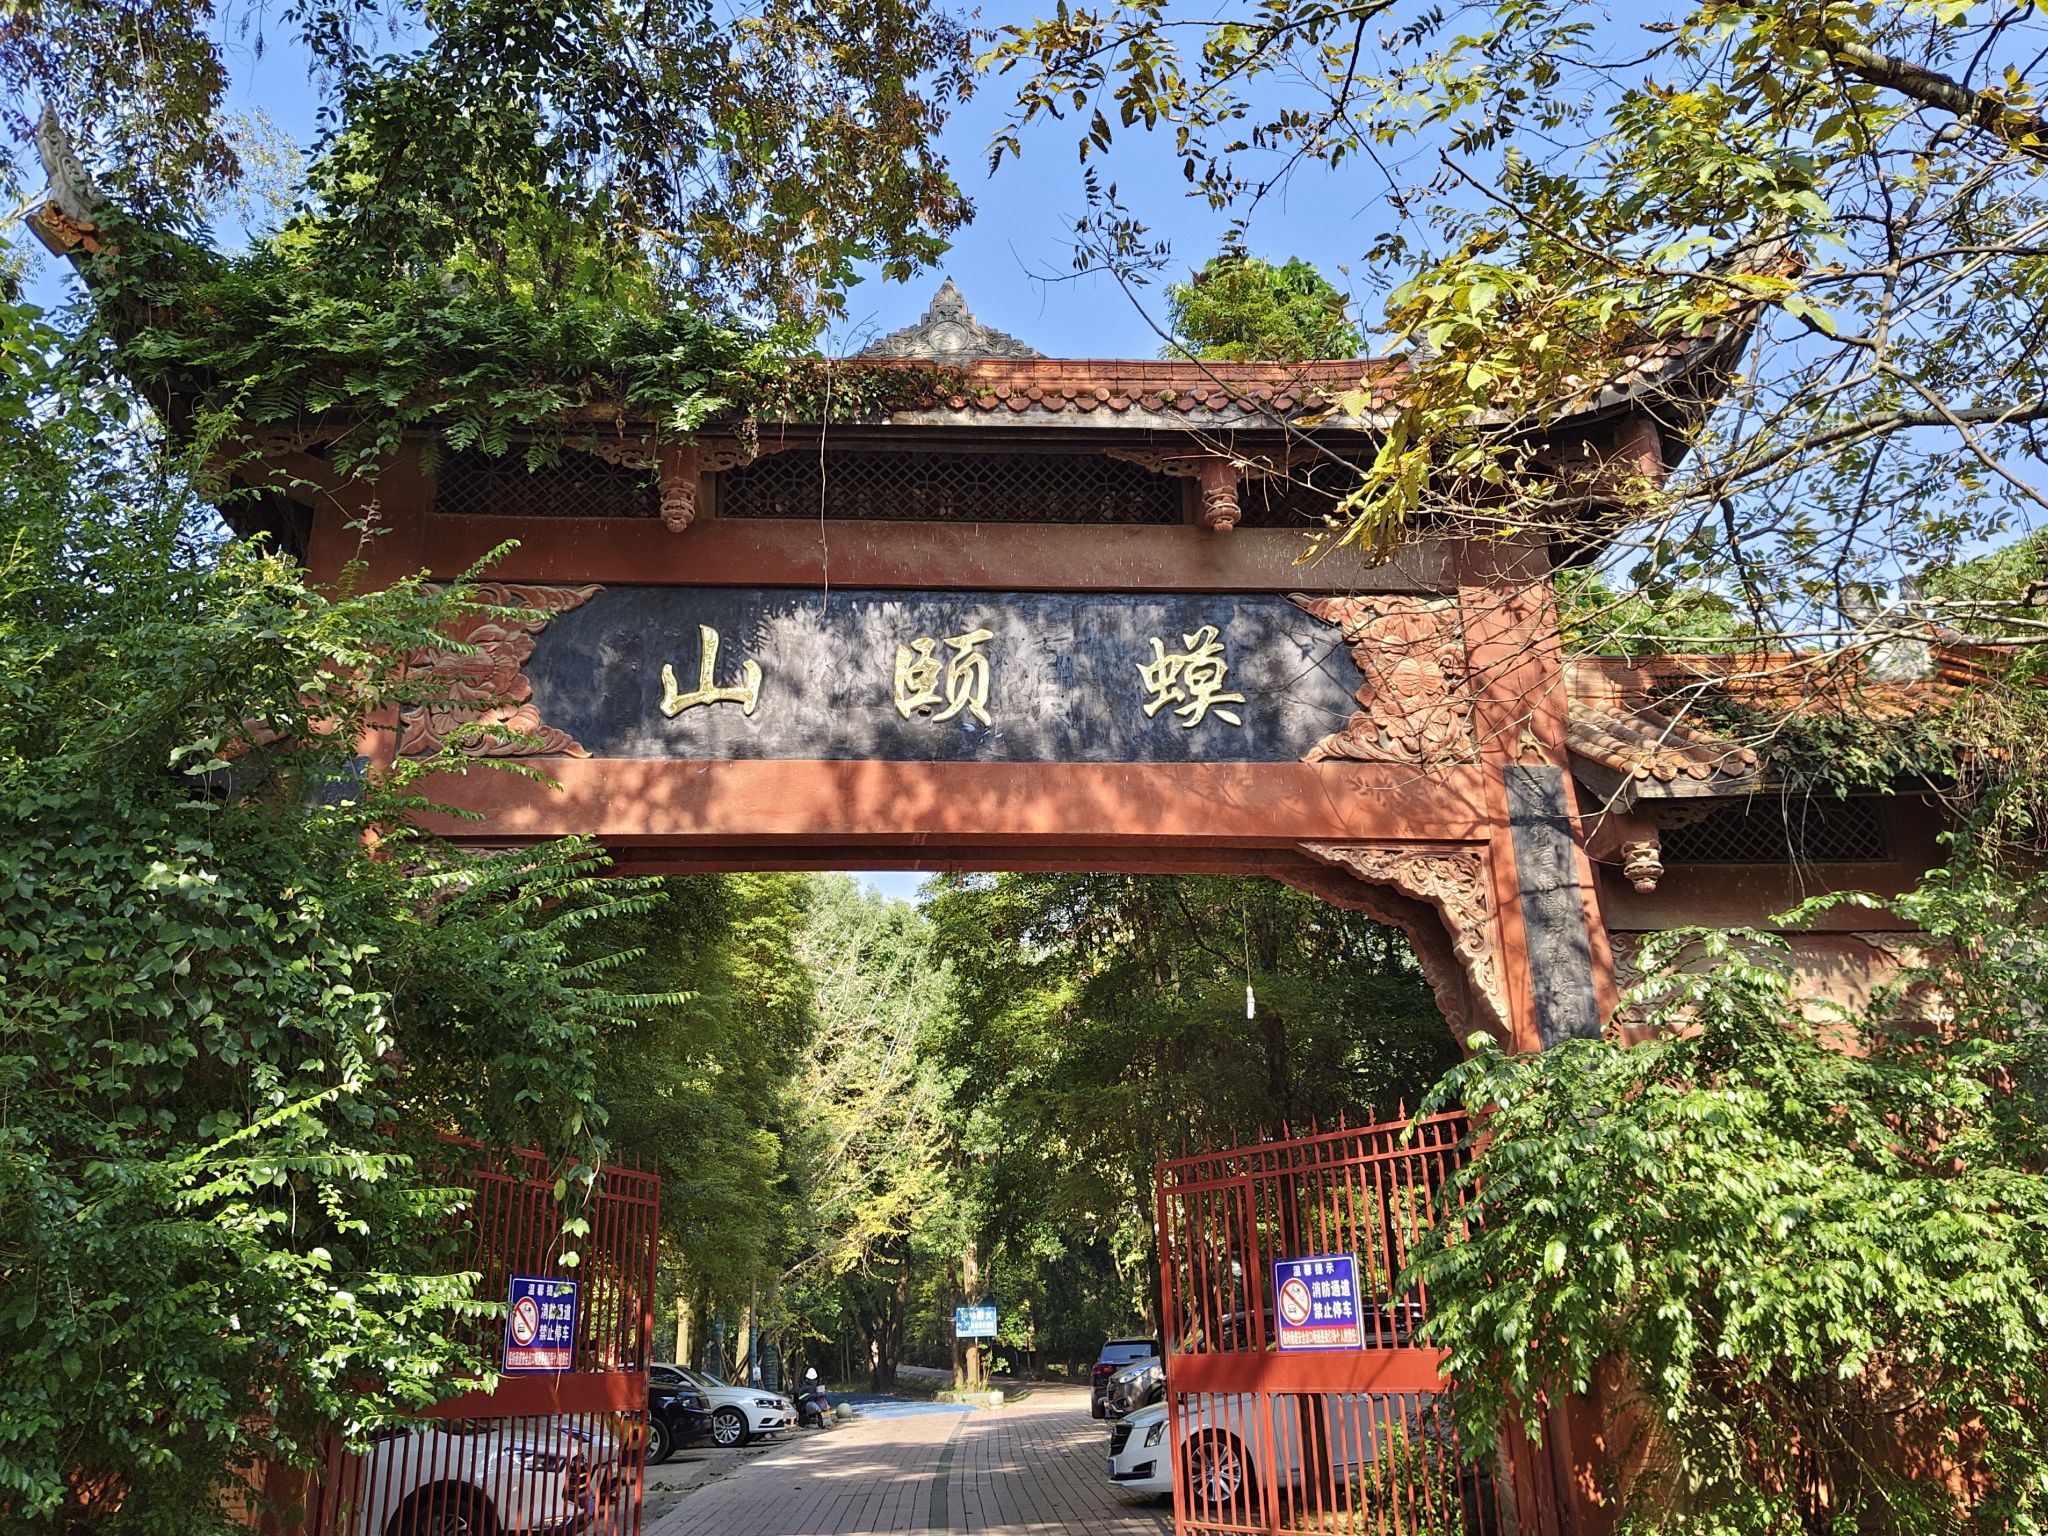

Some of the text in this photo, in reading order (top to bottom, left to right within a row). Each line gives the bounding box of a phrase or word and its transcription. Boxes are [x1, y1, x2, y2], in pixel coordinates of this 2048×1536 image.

[1293, 1263, 1334, 1276] 温馨提示
[528, 1284, 561, 1296] 温馨提
[1312, 1280, 1351, 1298] 消防通道
[1313, 1301, 1352, 1319] 禁止停车
[539, 1324, 569, 1341] 禁止停车
